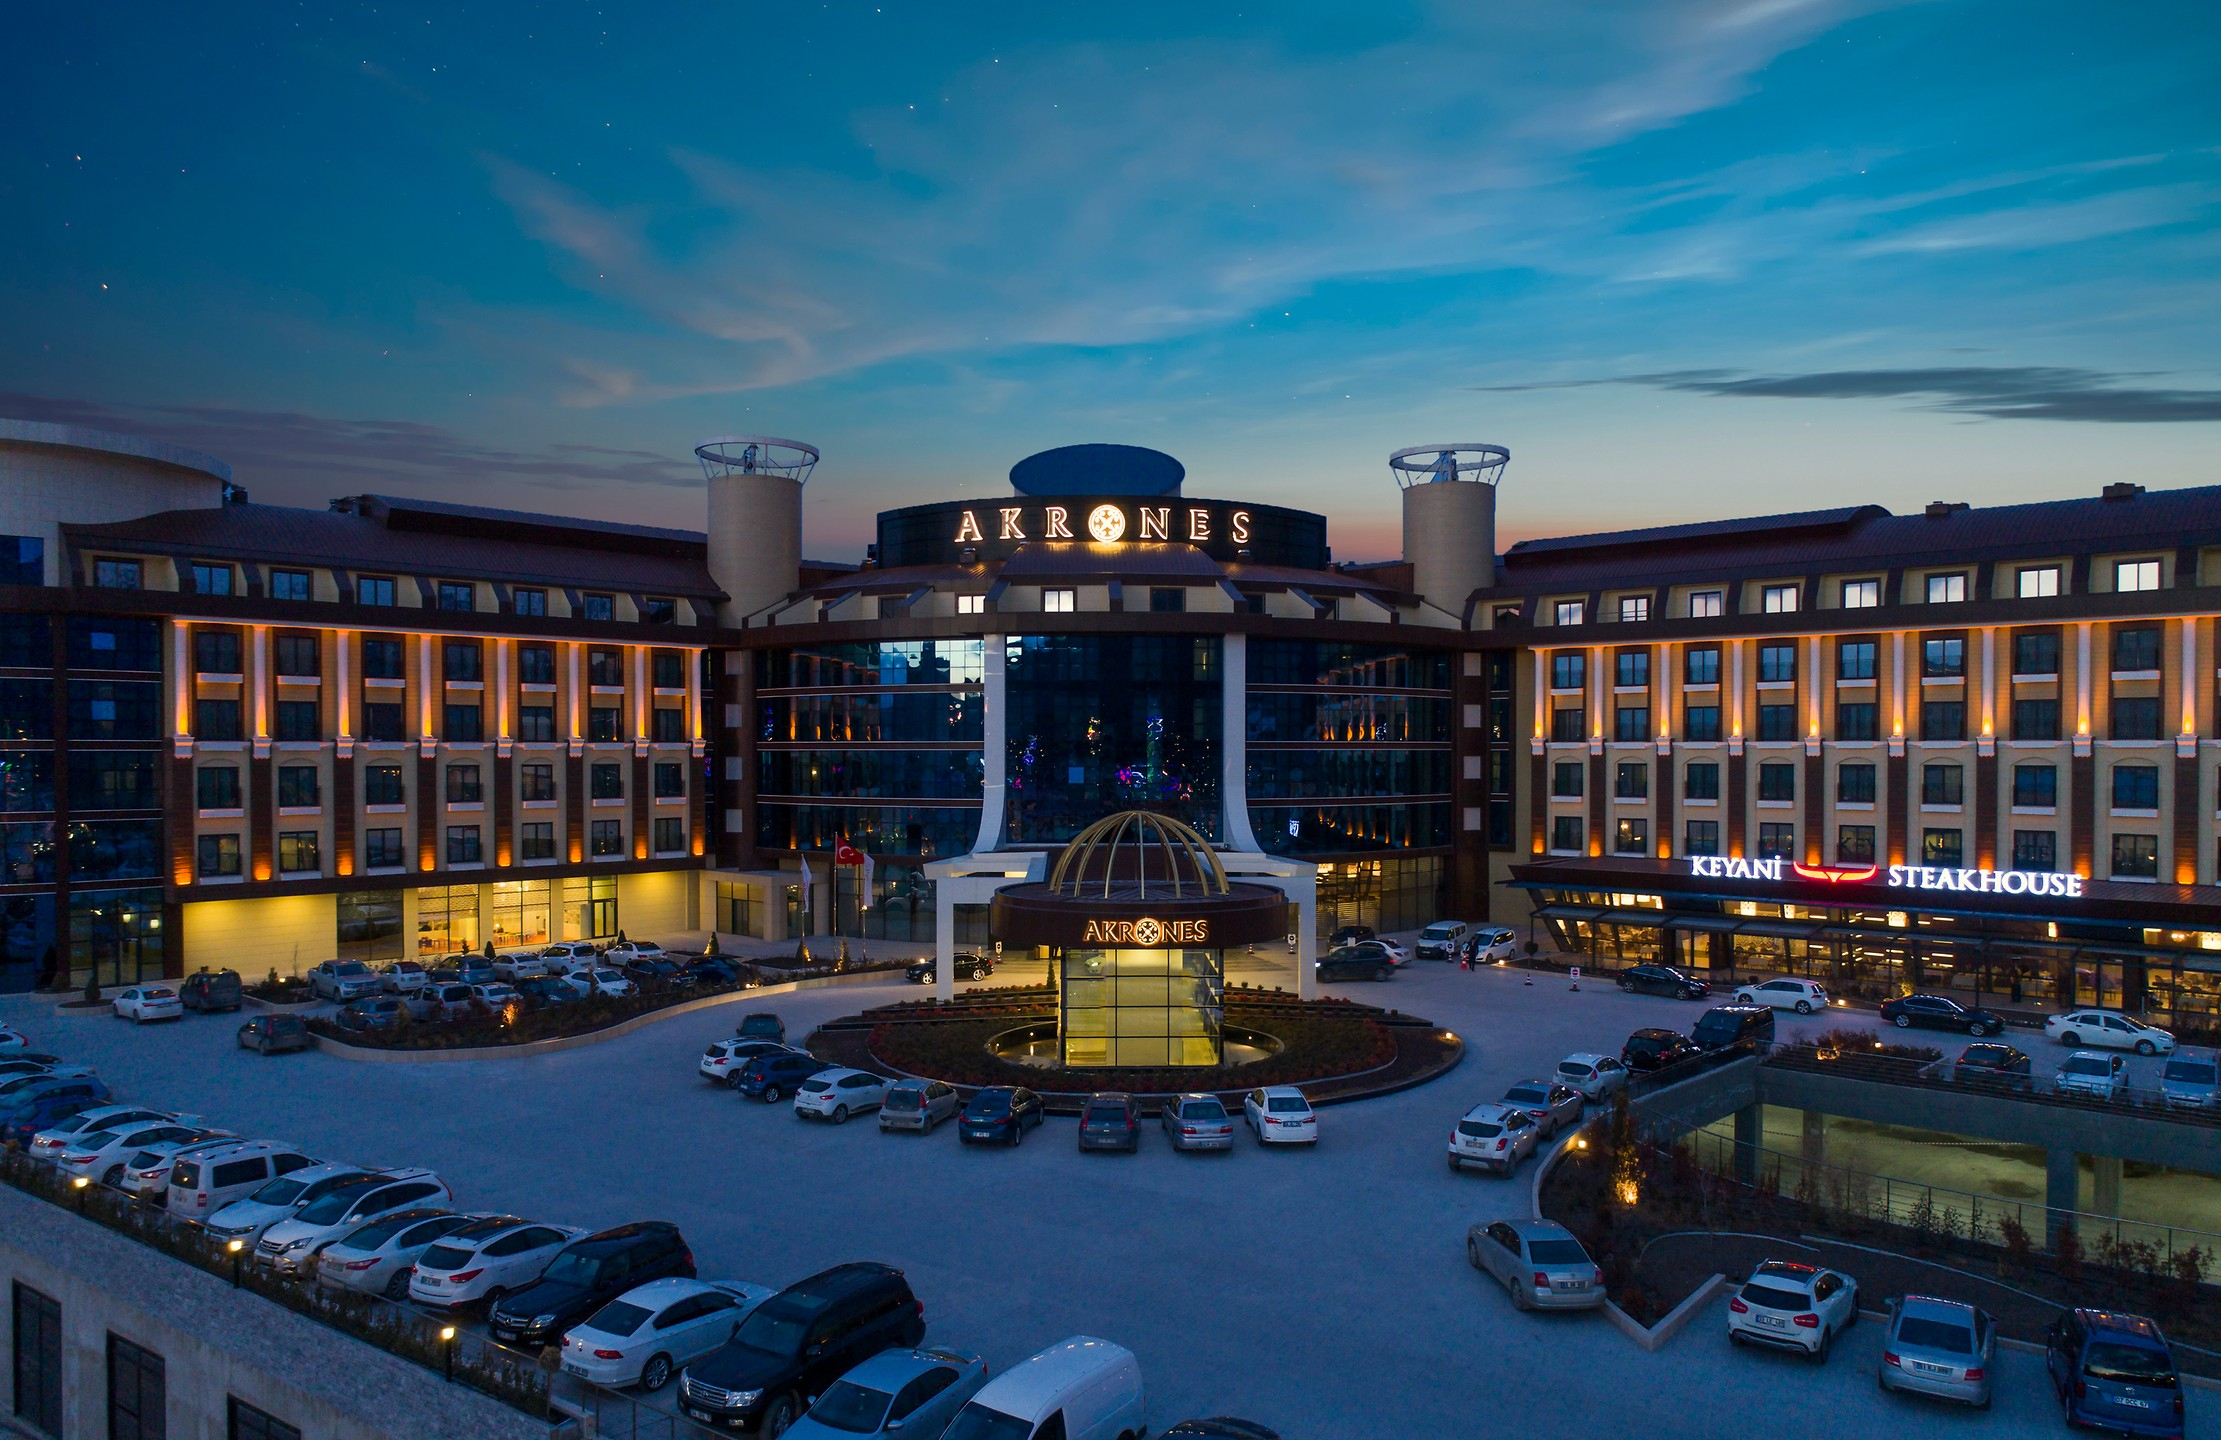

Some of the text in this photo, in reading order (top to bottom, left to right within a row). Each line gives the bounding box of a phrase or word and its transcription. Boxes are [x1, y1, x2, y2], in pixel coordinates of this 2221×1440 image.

[954, 503, 1250, 544] AKRONES
[1690, 854, 2084, 898] KEYANİ STEAKHOUSE
[1082, 917, 1209, 945] AKRONES
